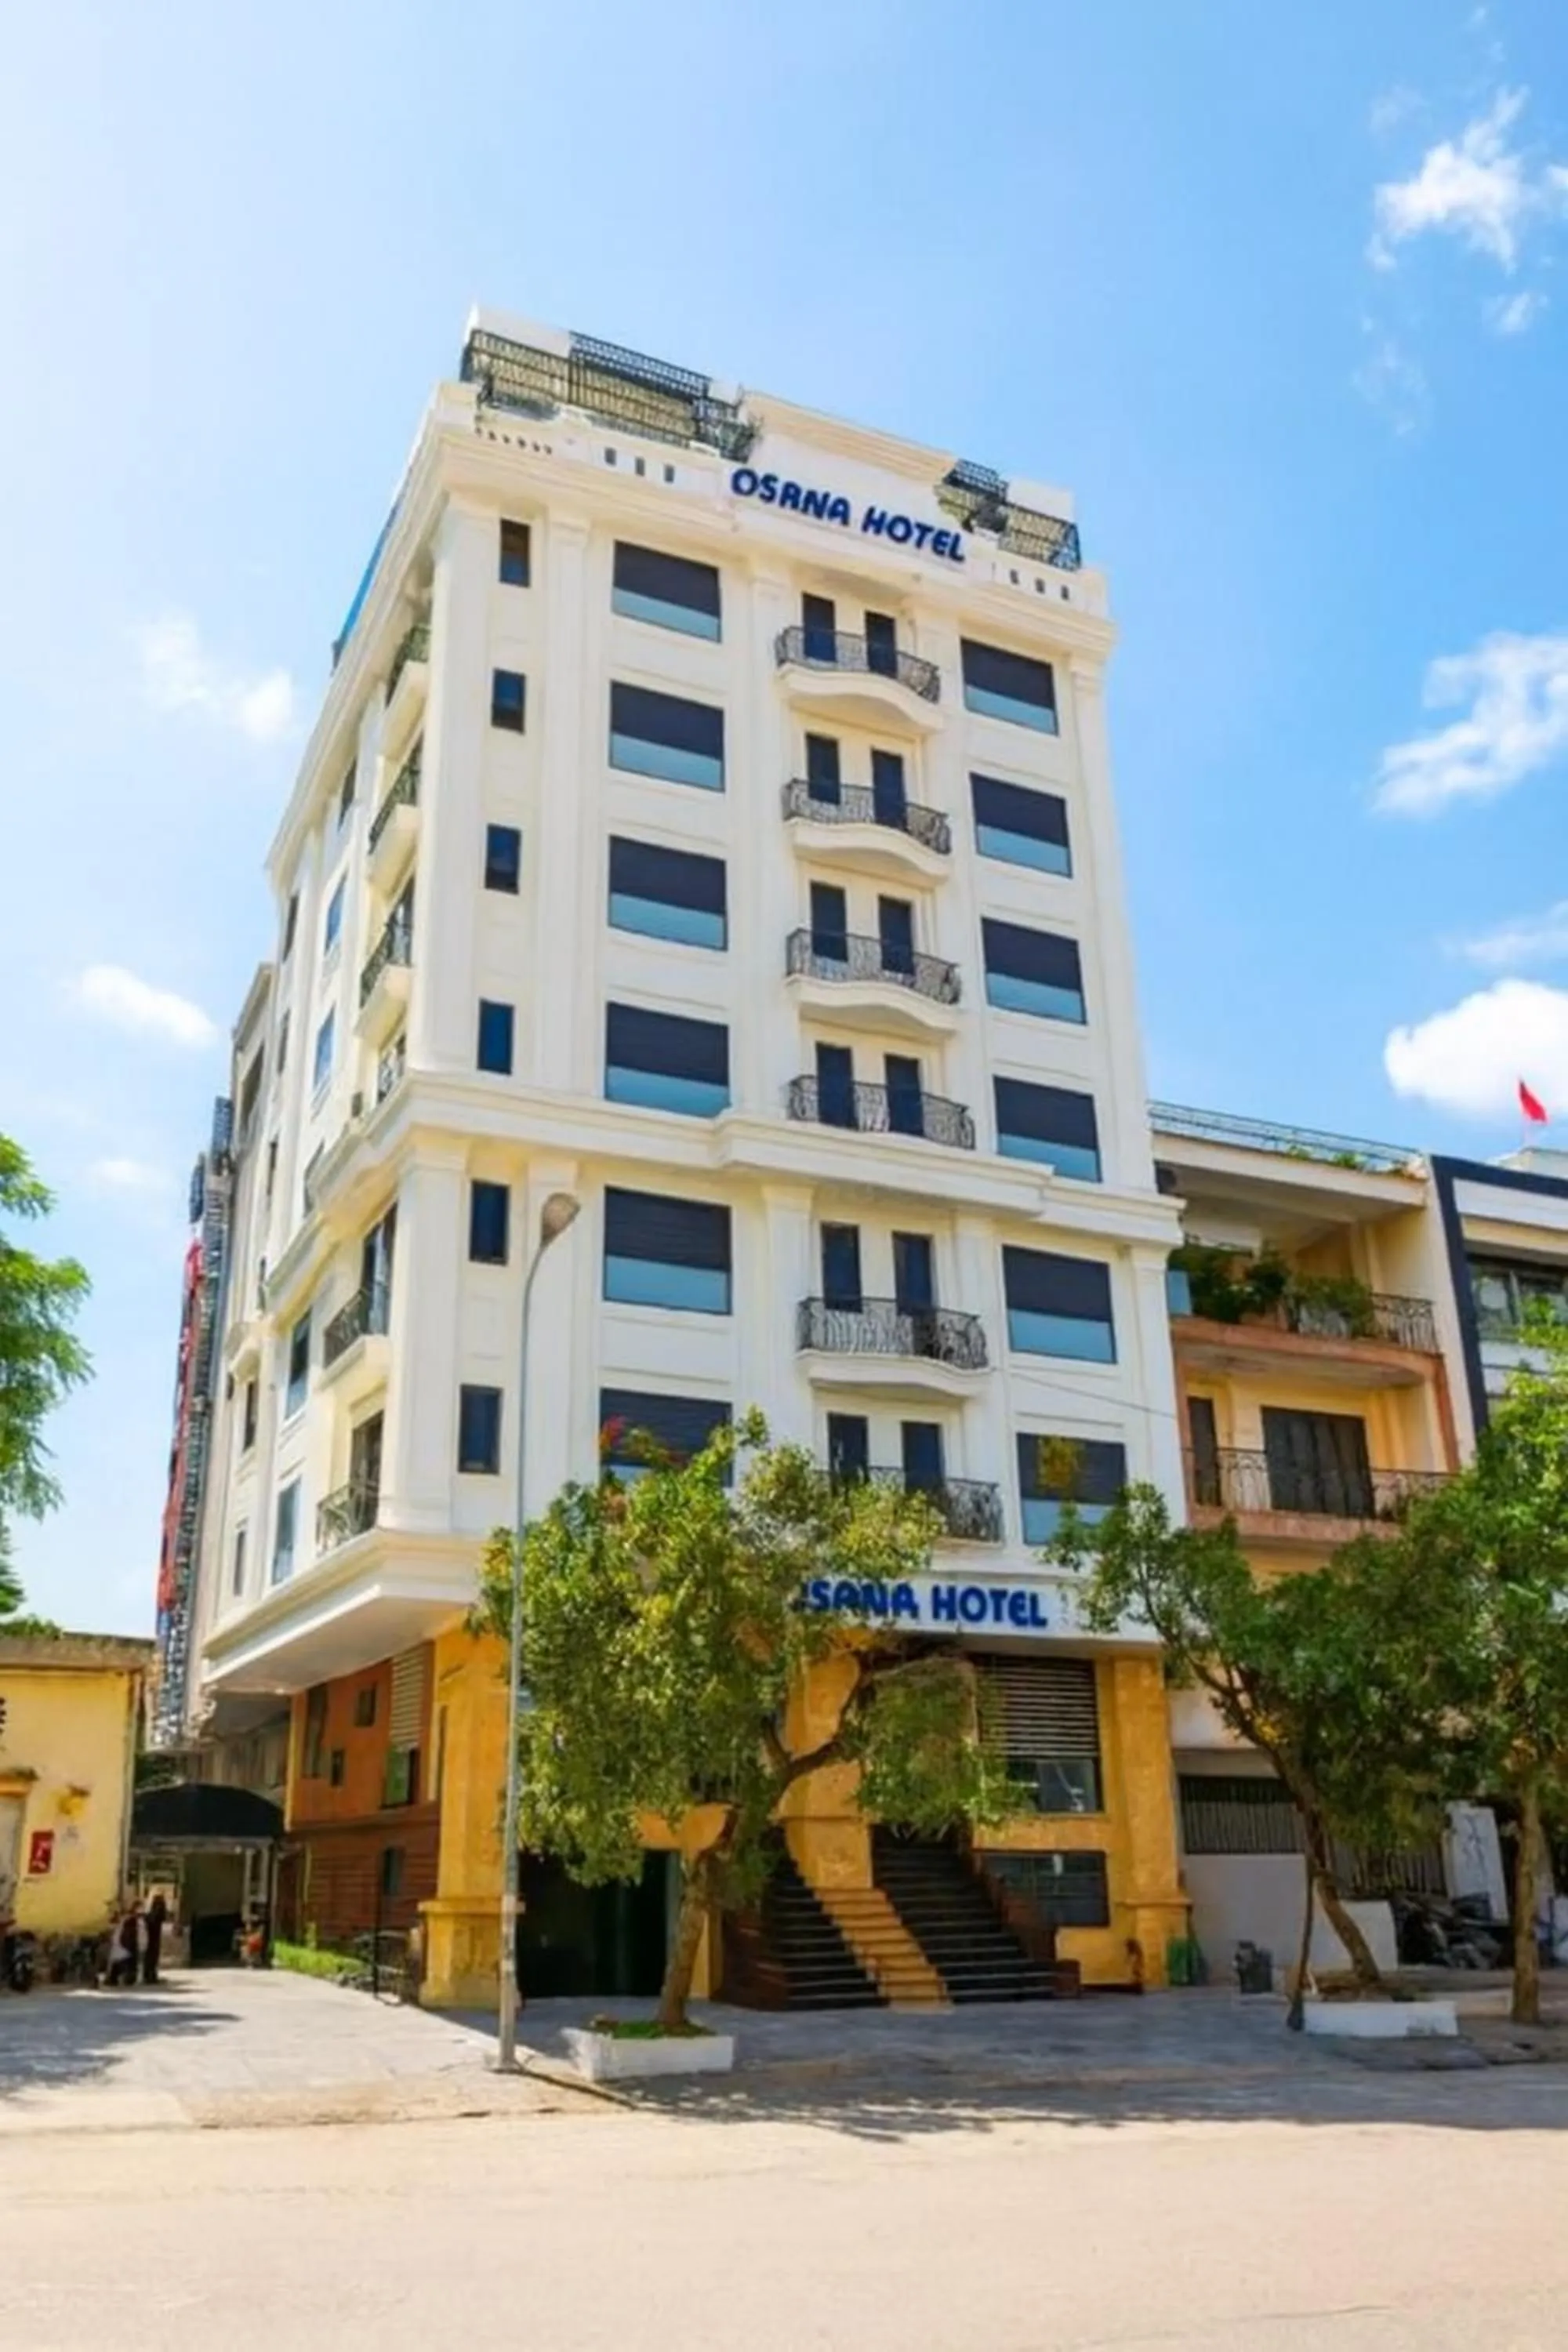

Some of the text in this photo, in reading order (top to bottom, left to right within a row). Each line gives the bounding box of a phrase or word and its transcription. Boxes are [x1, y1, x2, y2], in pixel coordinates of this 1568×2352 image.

[731, 468, 964, 562] OSANA HOTEL
[793, 1579, 1047, 1628] SANA HOTEL
